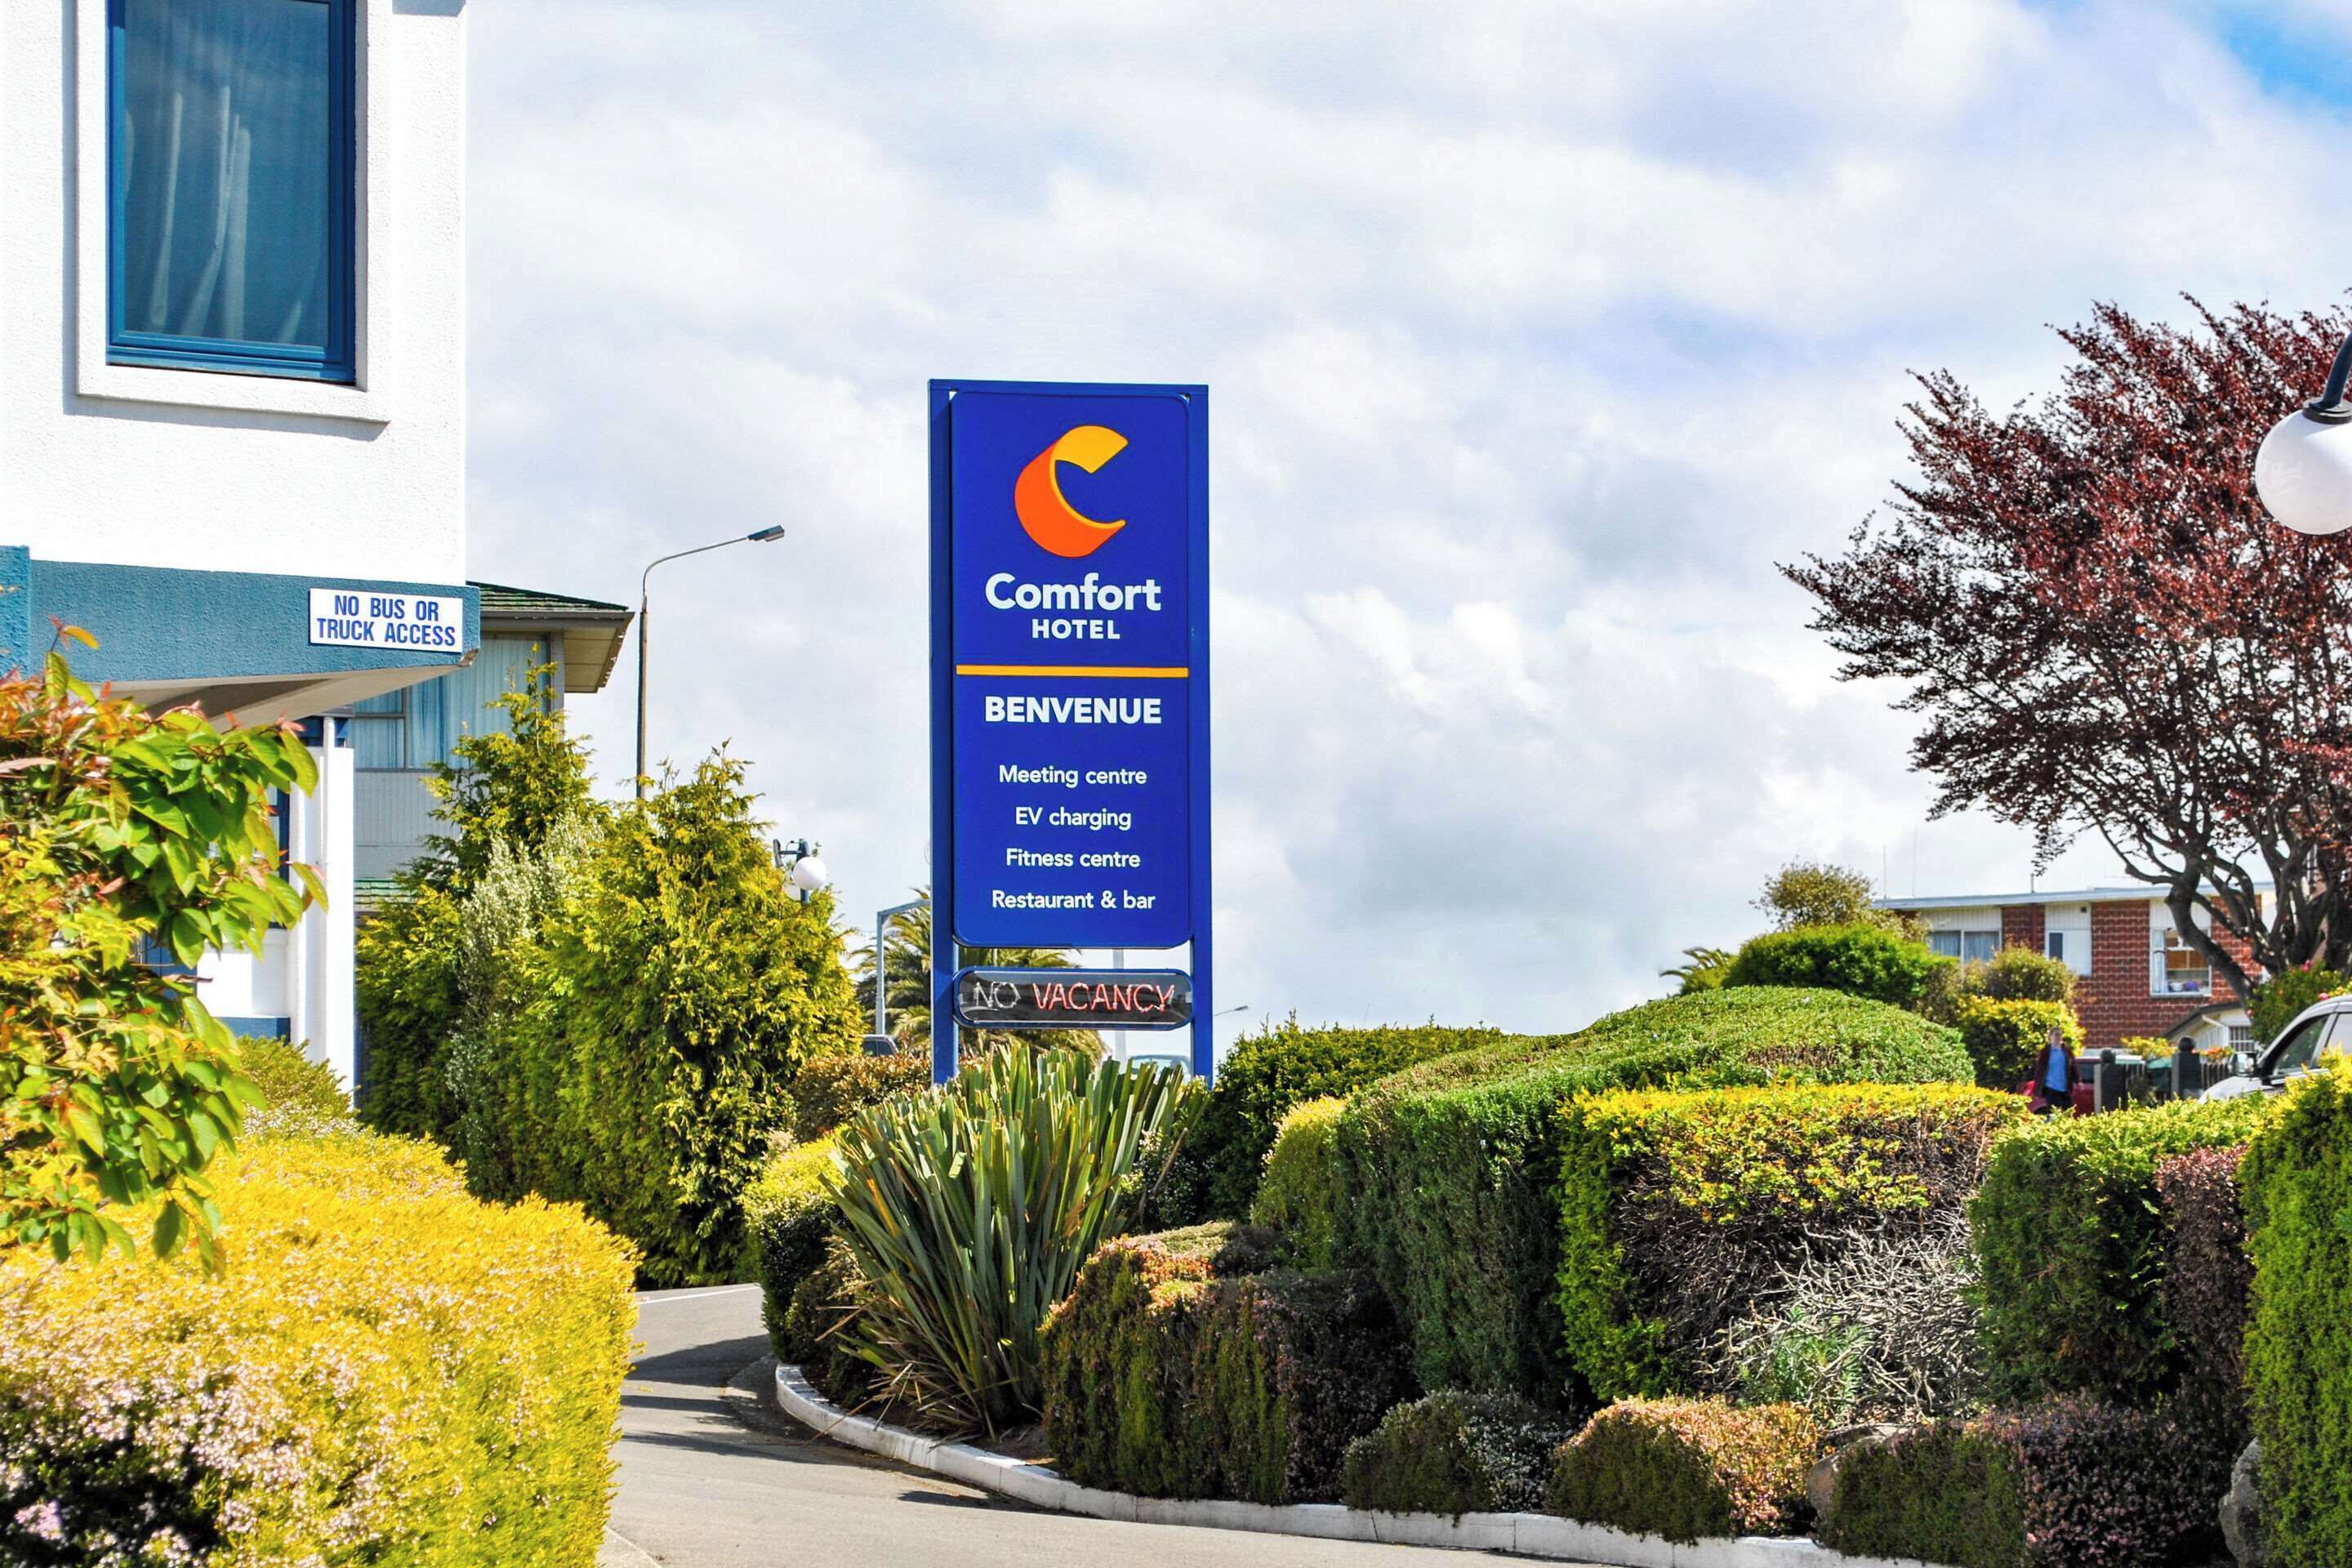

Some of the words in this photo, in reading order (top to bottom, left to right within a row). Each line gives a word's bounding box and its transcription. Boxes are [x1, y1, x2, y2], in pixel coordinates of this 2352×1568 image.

[985, 572, 1161, 612] Comfort
[334, 595, 359, 617] NO
[370, 597, 405, 620] BUS
[416, 600, 439, 622] OR
[316, 618, 375, 641] TRUCK
[384, 622, 456, 647] ACCESS
[1031, 618, 1120, 639] HOTEL
[985, 696, 1162, 724] BENVENUE
[998, 764, 1078, 789] Meeting
[1085, 768, 1147, 785] centre
[1015, 807, 1043, 826] EV
[1049, 807, 1132, 831] charging
[1005, 848, 1074, 867] Fitness
[1079, 851, 1141, 868] centre
[991, 890, 1094, 909] Restaurant
[1100, 890, 1116, 909] &
[1123, 890, 1156, 909] bar
[973, 982, 1020, 1009] NO
[1032, 982, 1175, 1013] VACANCY
